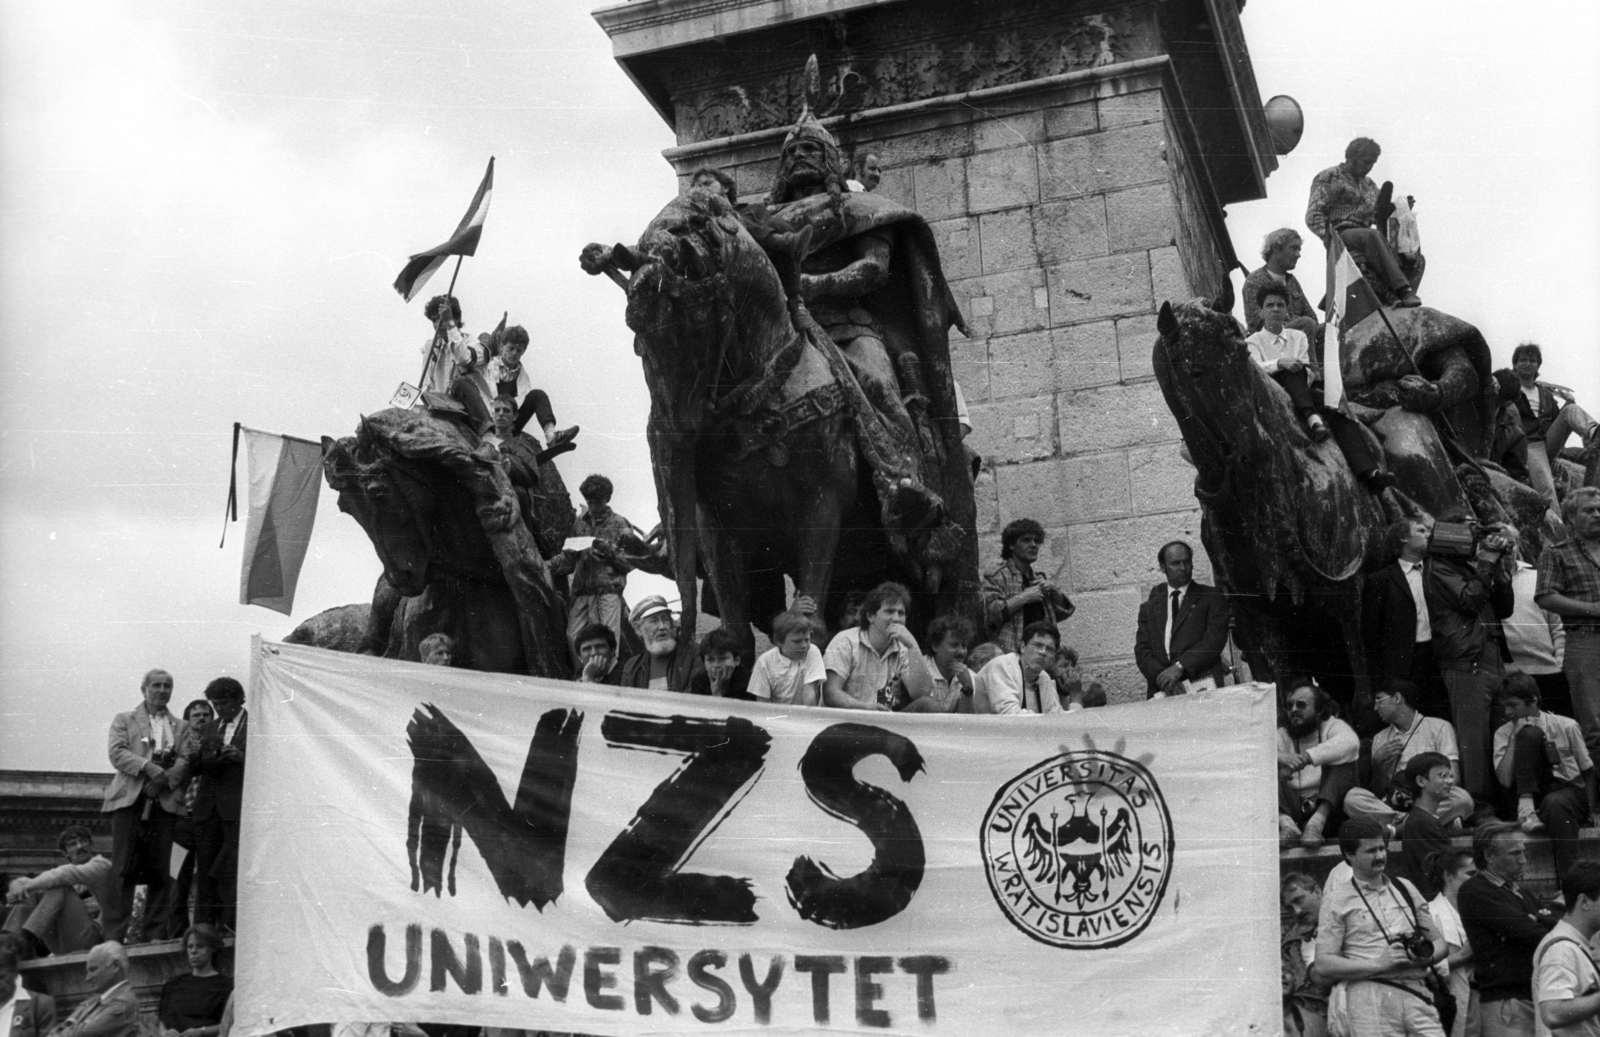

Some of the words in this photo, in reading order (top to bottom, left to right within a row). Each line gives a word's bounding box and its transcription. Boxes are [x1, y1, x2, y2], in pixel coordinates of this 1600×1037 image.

[406, 703, 927, 929] NZS
[991, 762, 1150, 833] UNIVERSITAS
[994, 842, 1162, 937] WRATISLAVIENSIS
[367, 923, 950, 1027] UNIWERSYTET
